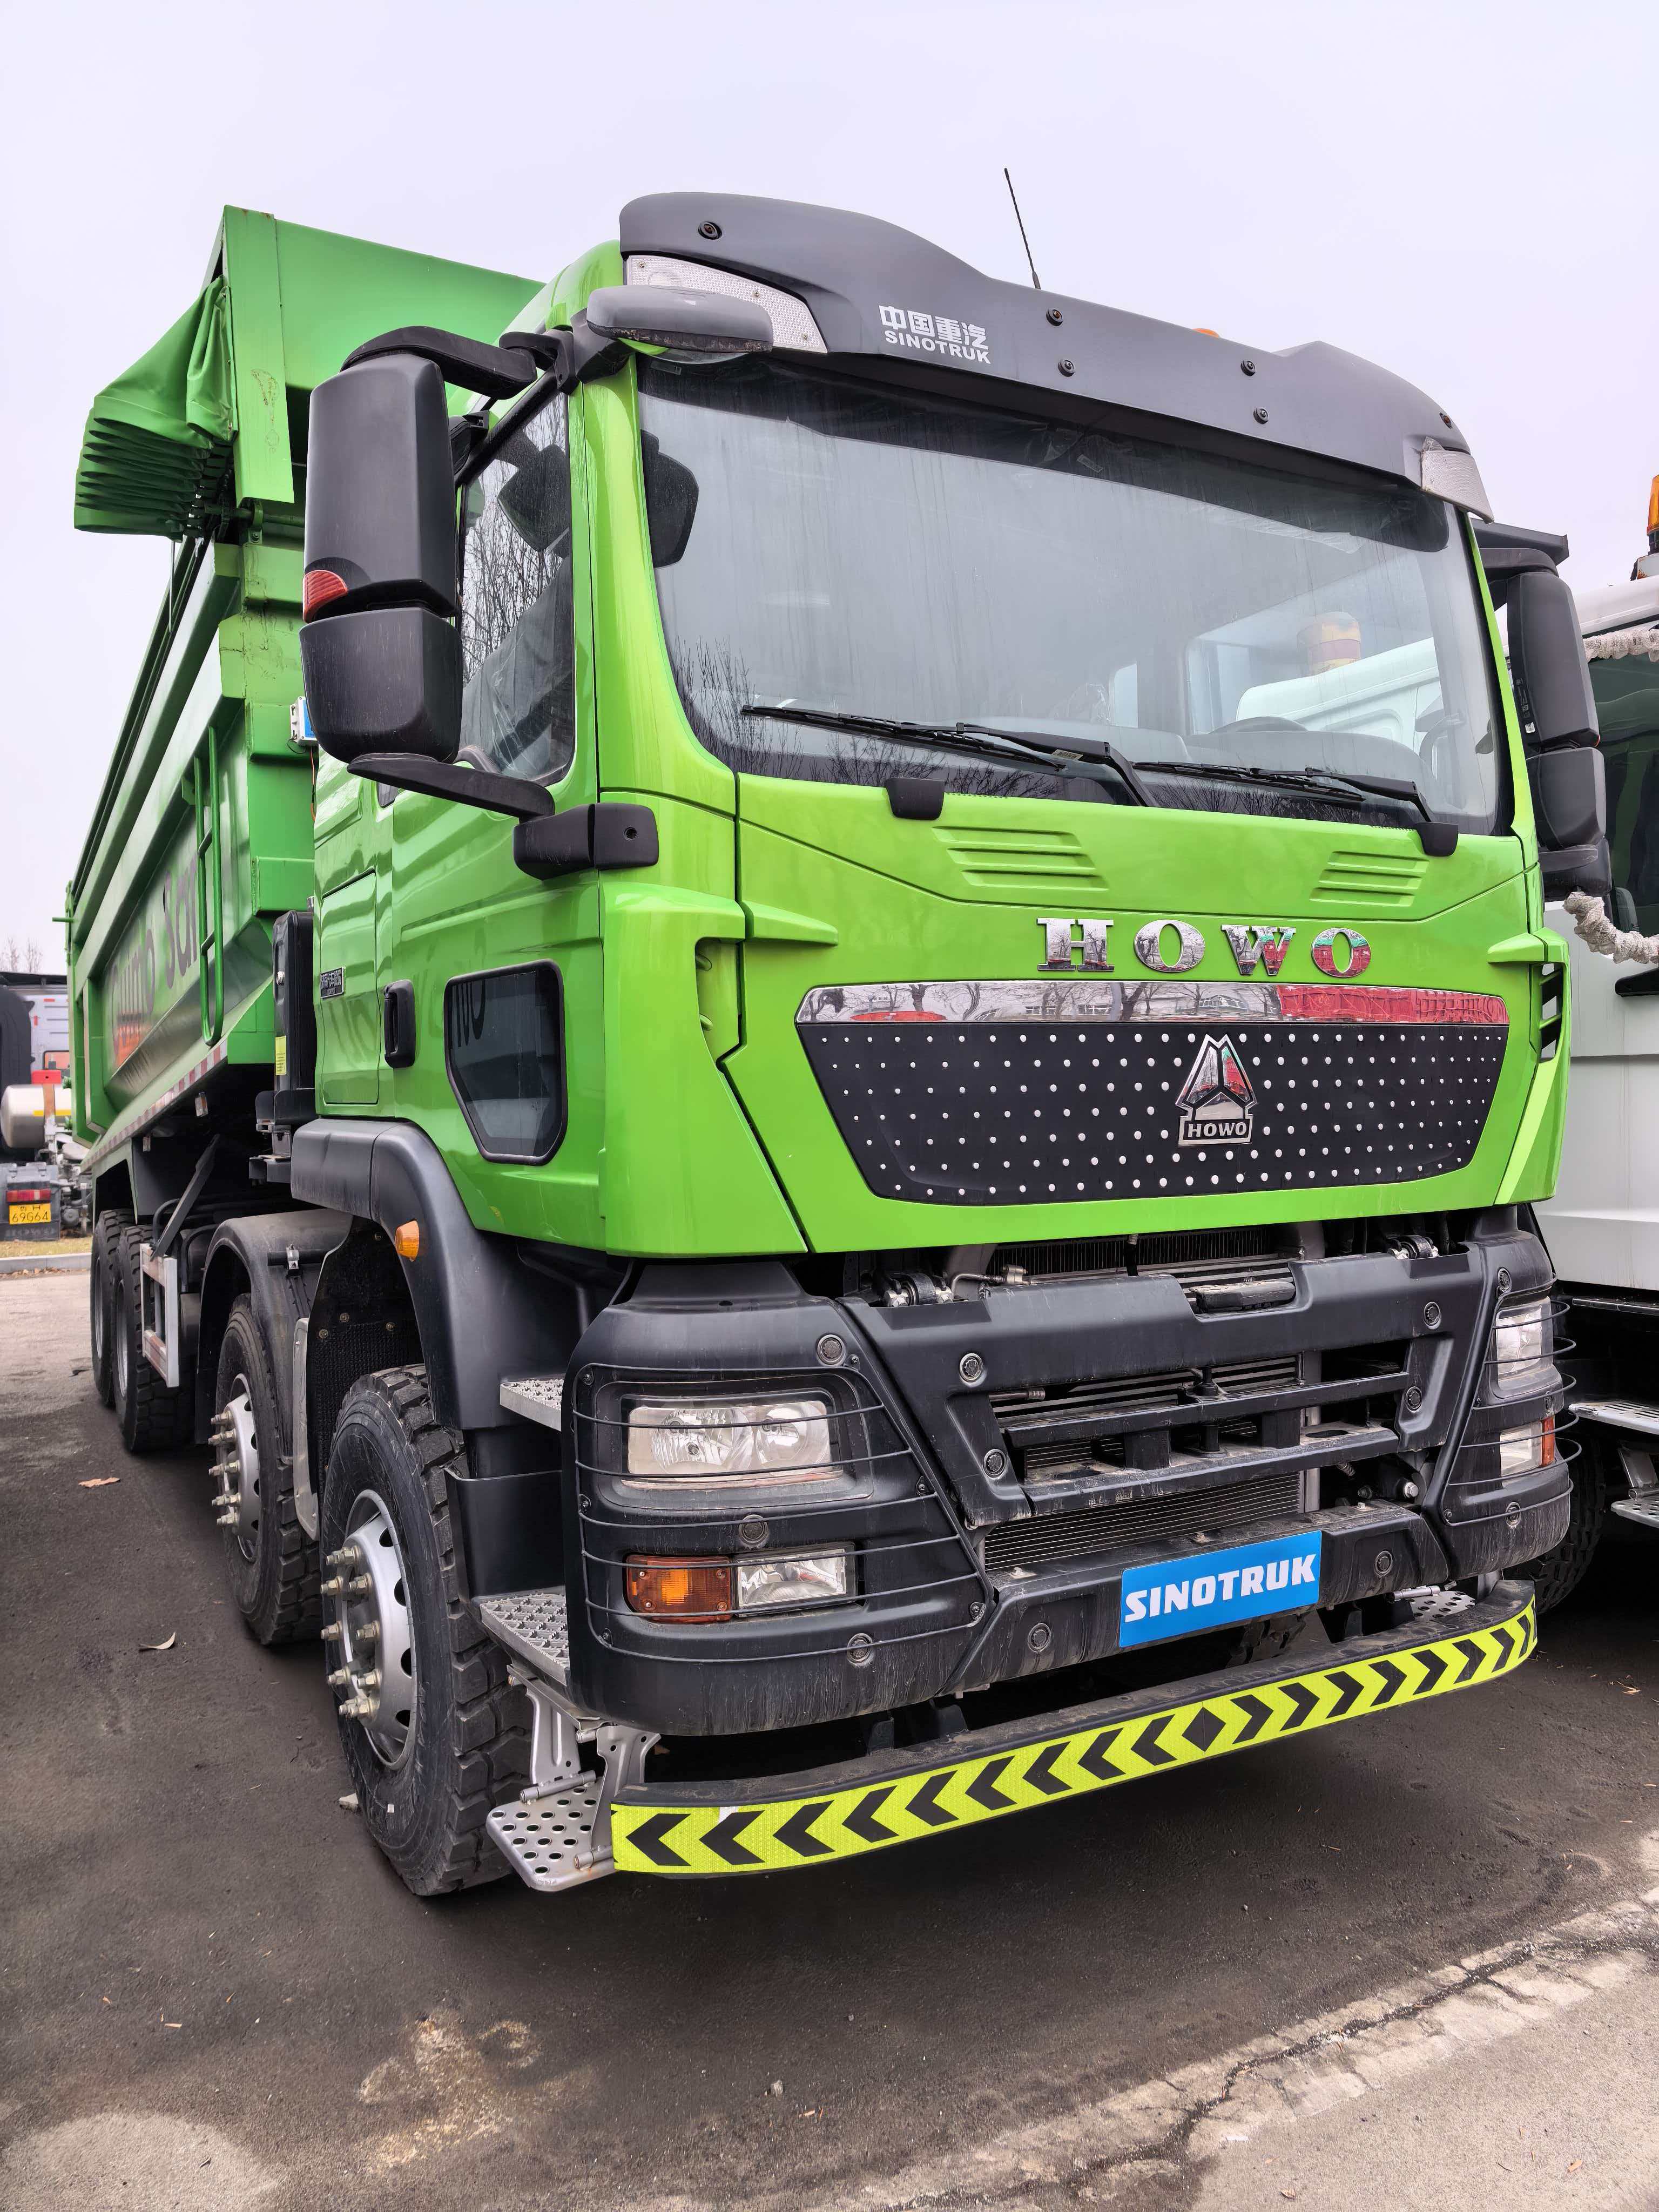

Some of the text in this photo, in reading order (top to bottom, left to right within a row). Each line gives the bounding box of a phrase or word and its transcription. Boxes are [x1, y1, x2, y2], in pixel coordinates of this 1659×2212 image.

[879, 305, 988, 350] 中国重汽
[885, 330, 991, 364] SINOTRUK
[1037, 918, 1371, 977] HOWO
[1188, 1122, 1247, 1137] HOWO
[1124, 1554, 1317, 1622] SINOTRUK
